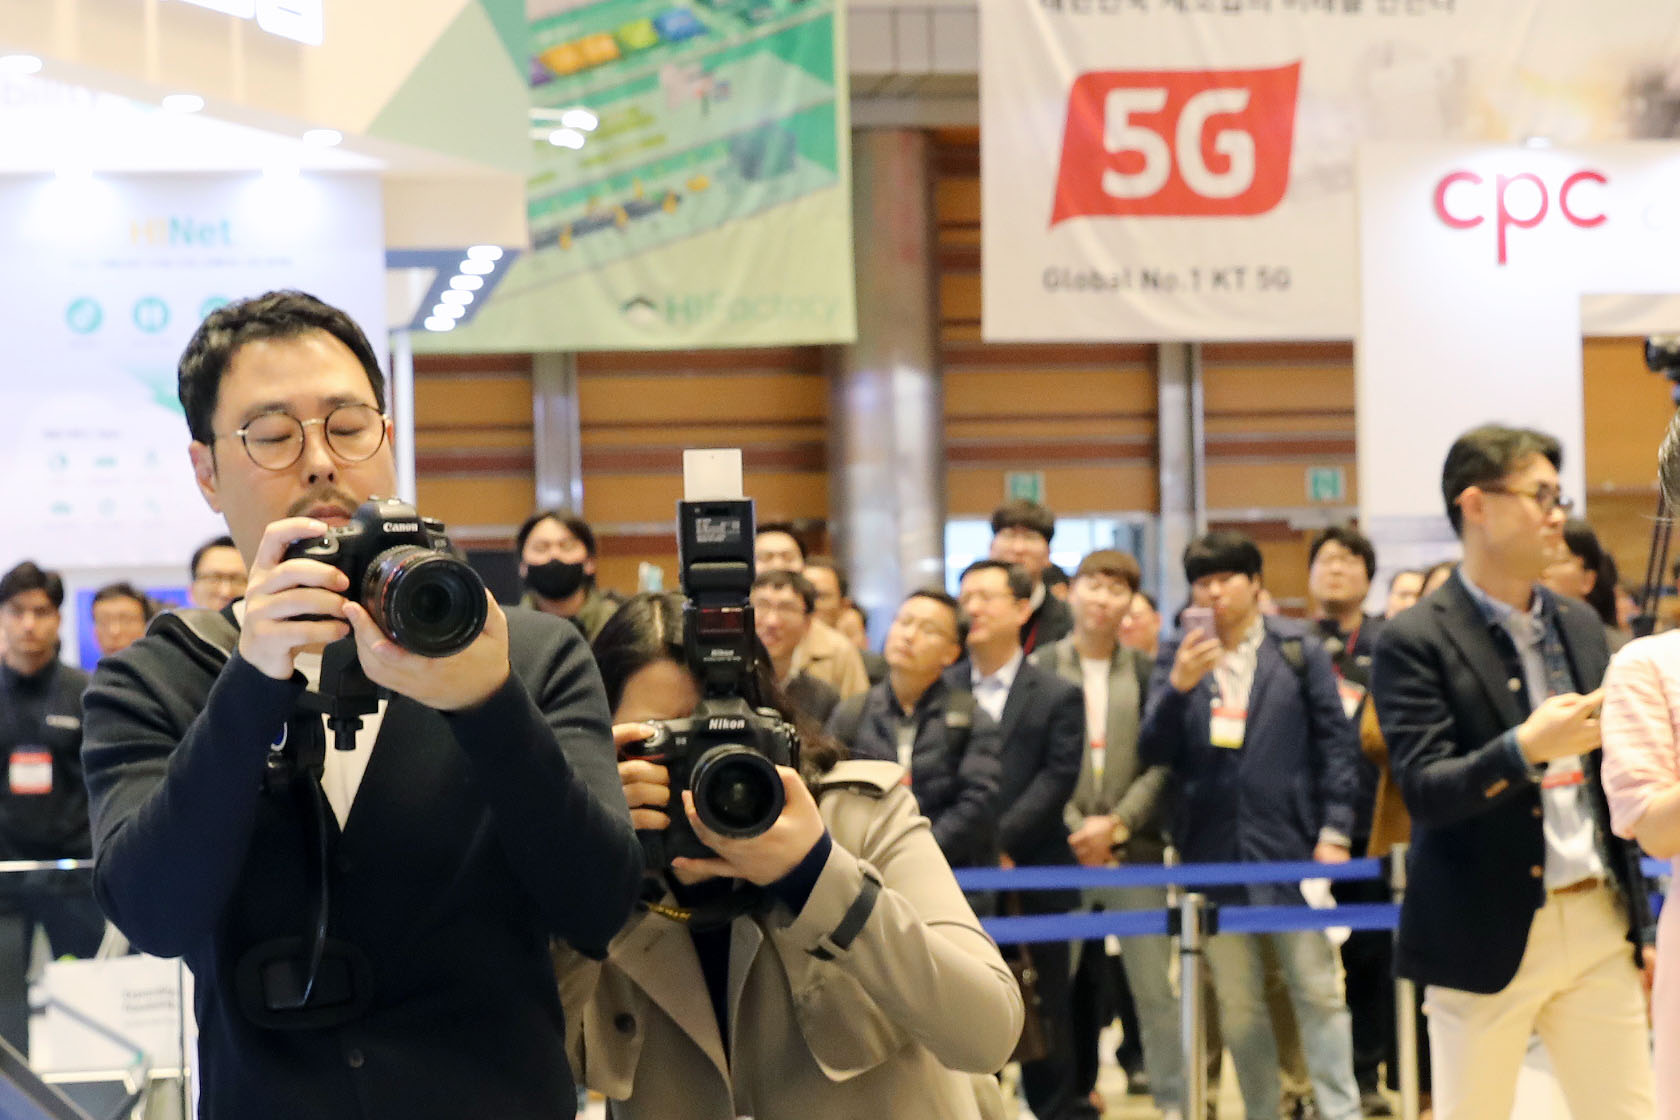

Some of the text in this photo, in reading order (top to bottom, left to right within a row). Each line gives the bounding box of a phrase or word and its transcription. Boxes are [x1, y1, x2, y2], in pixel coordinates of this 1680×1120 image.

[1102, 87, 1255, 199] 5G
[1433, 169, 1609, 267] cpc
[1042, 265, 1292, 293] Global No.1 KT 5G
[383, 521, 419, 533] Canon
[709, 719, 745, 730] Nikon
